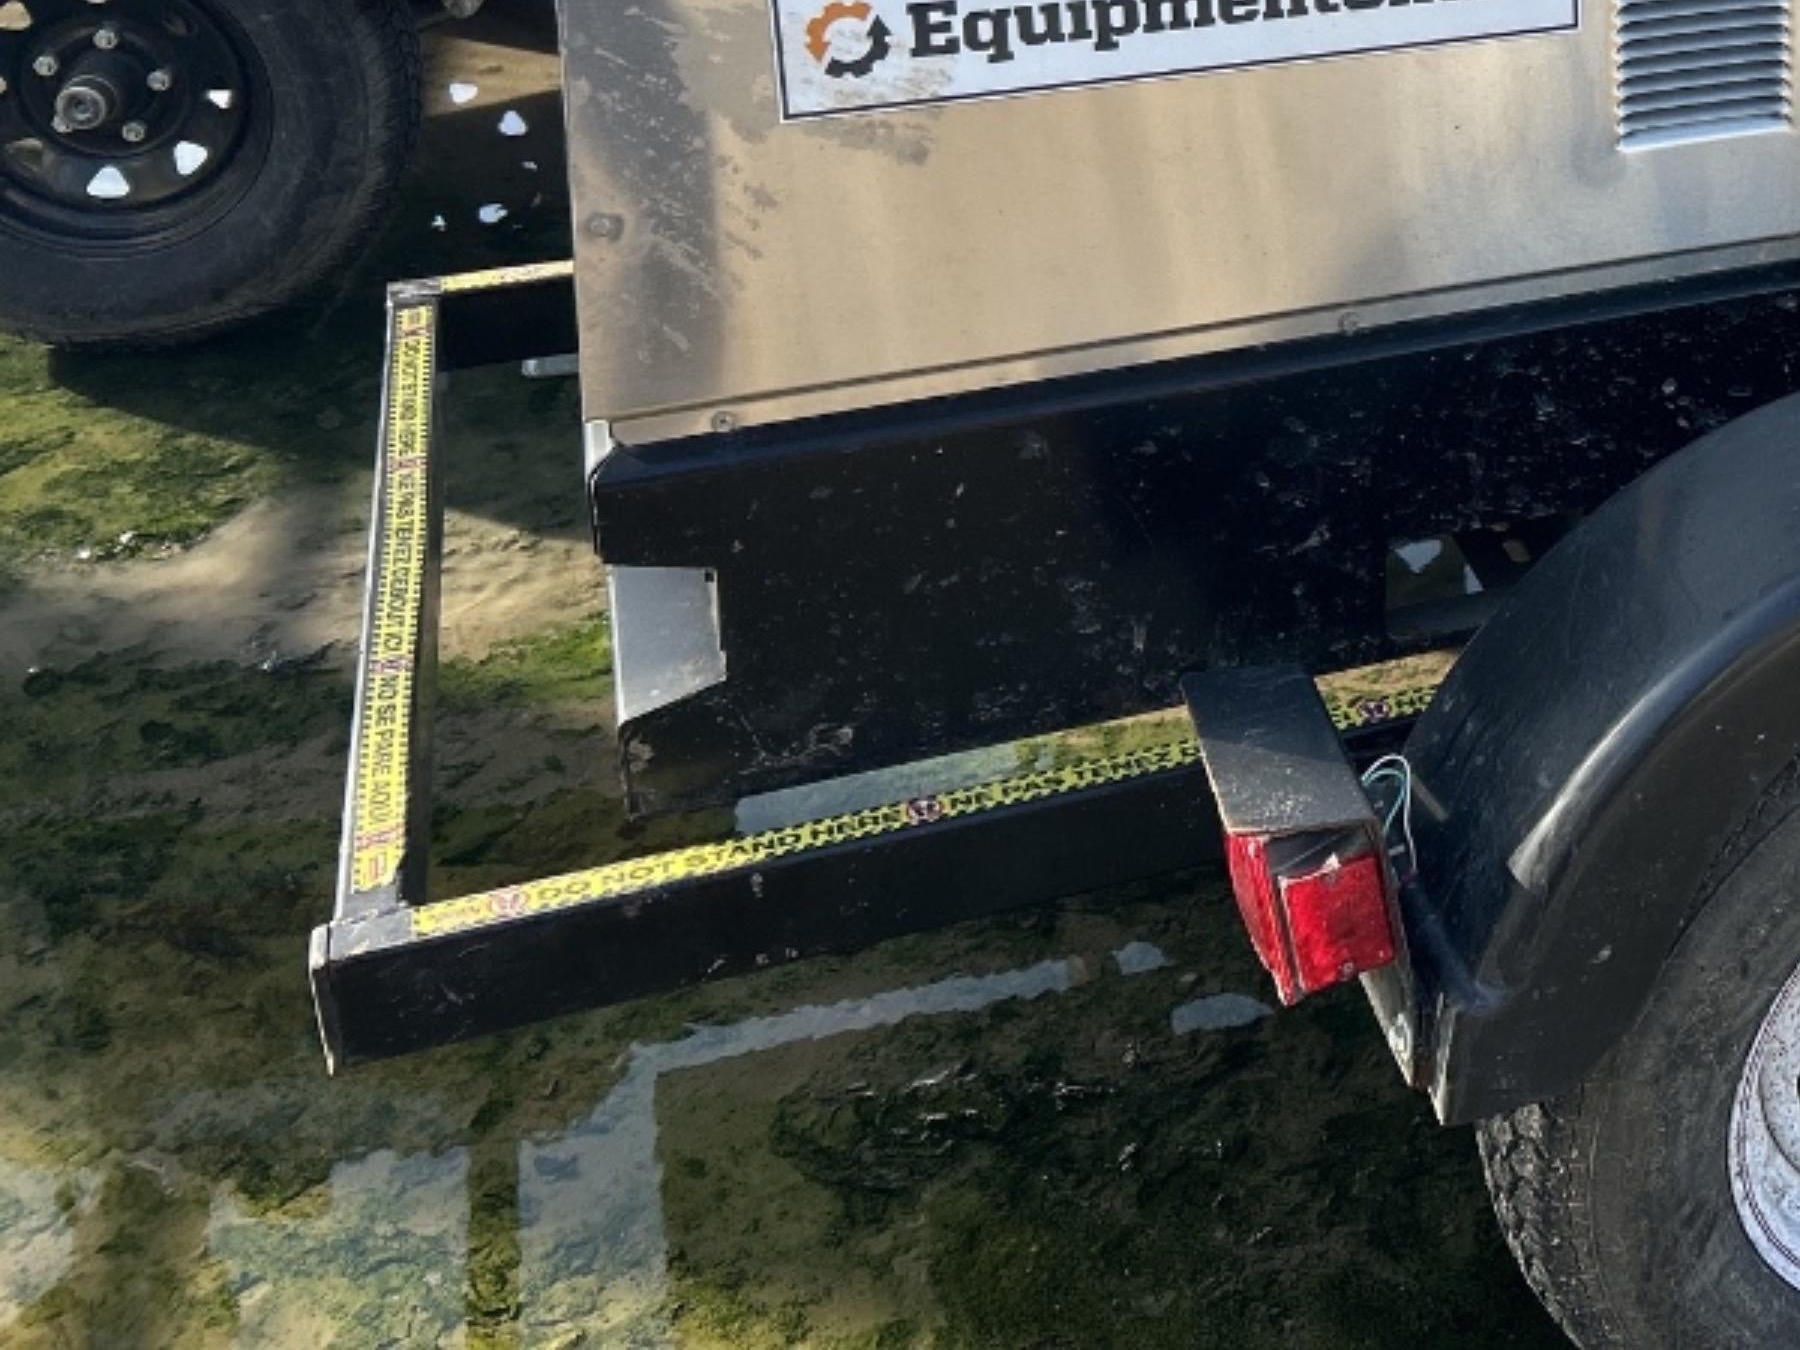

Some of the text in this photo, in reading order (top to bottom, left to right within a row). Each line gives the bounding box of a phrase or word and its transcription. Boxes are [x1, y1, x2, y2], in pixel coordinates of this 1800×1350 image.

[537, 880, 591, 903] DO
[602, 861, 675, 886] NOT
[685, 831, 802, 868] STAND
